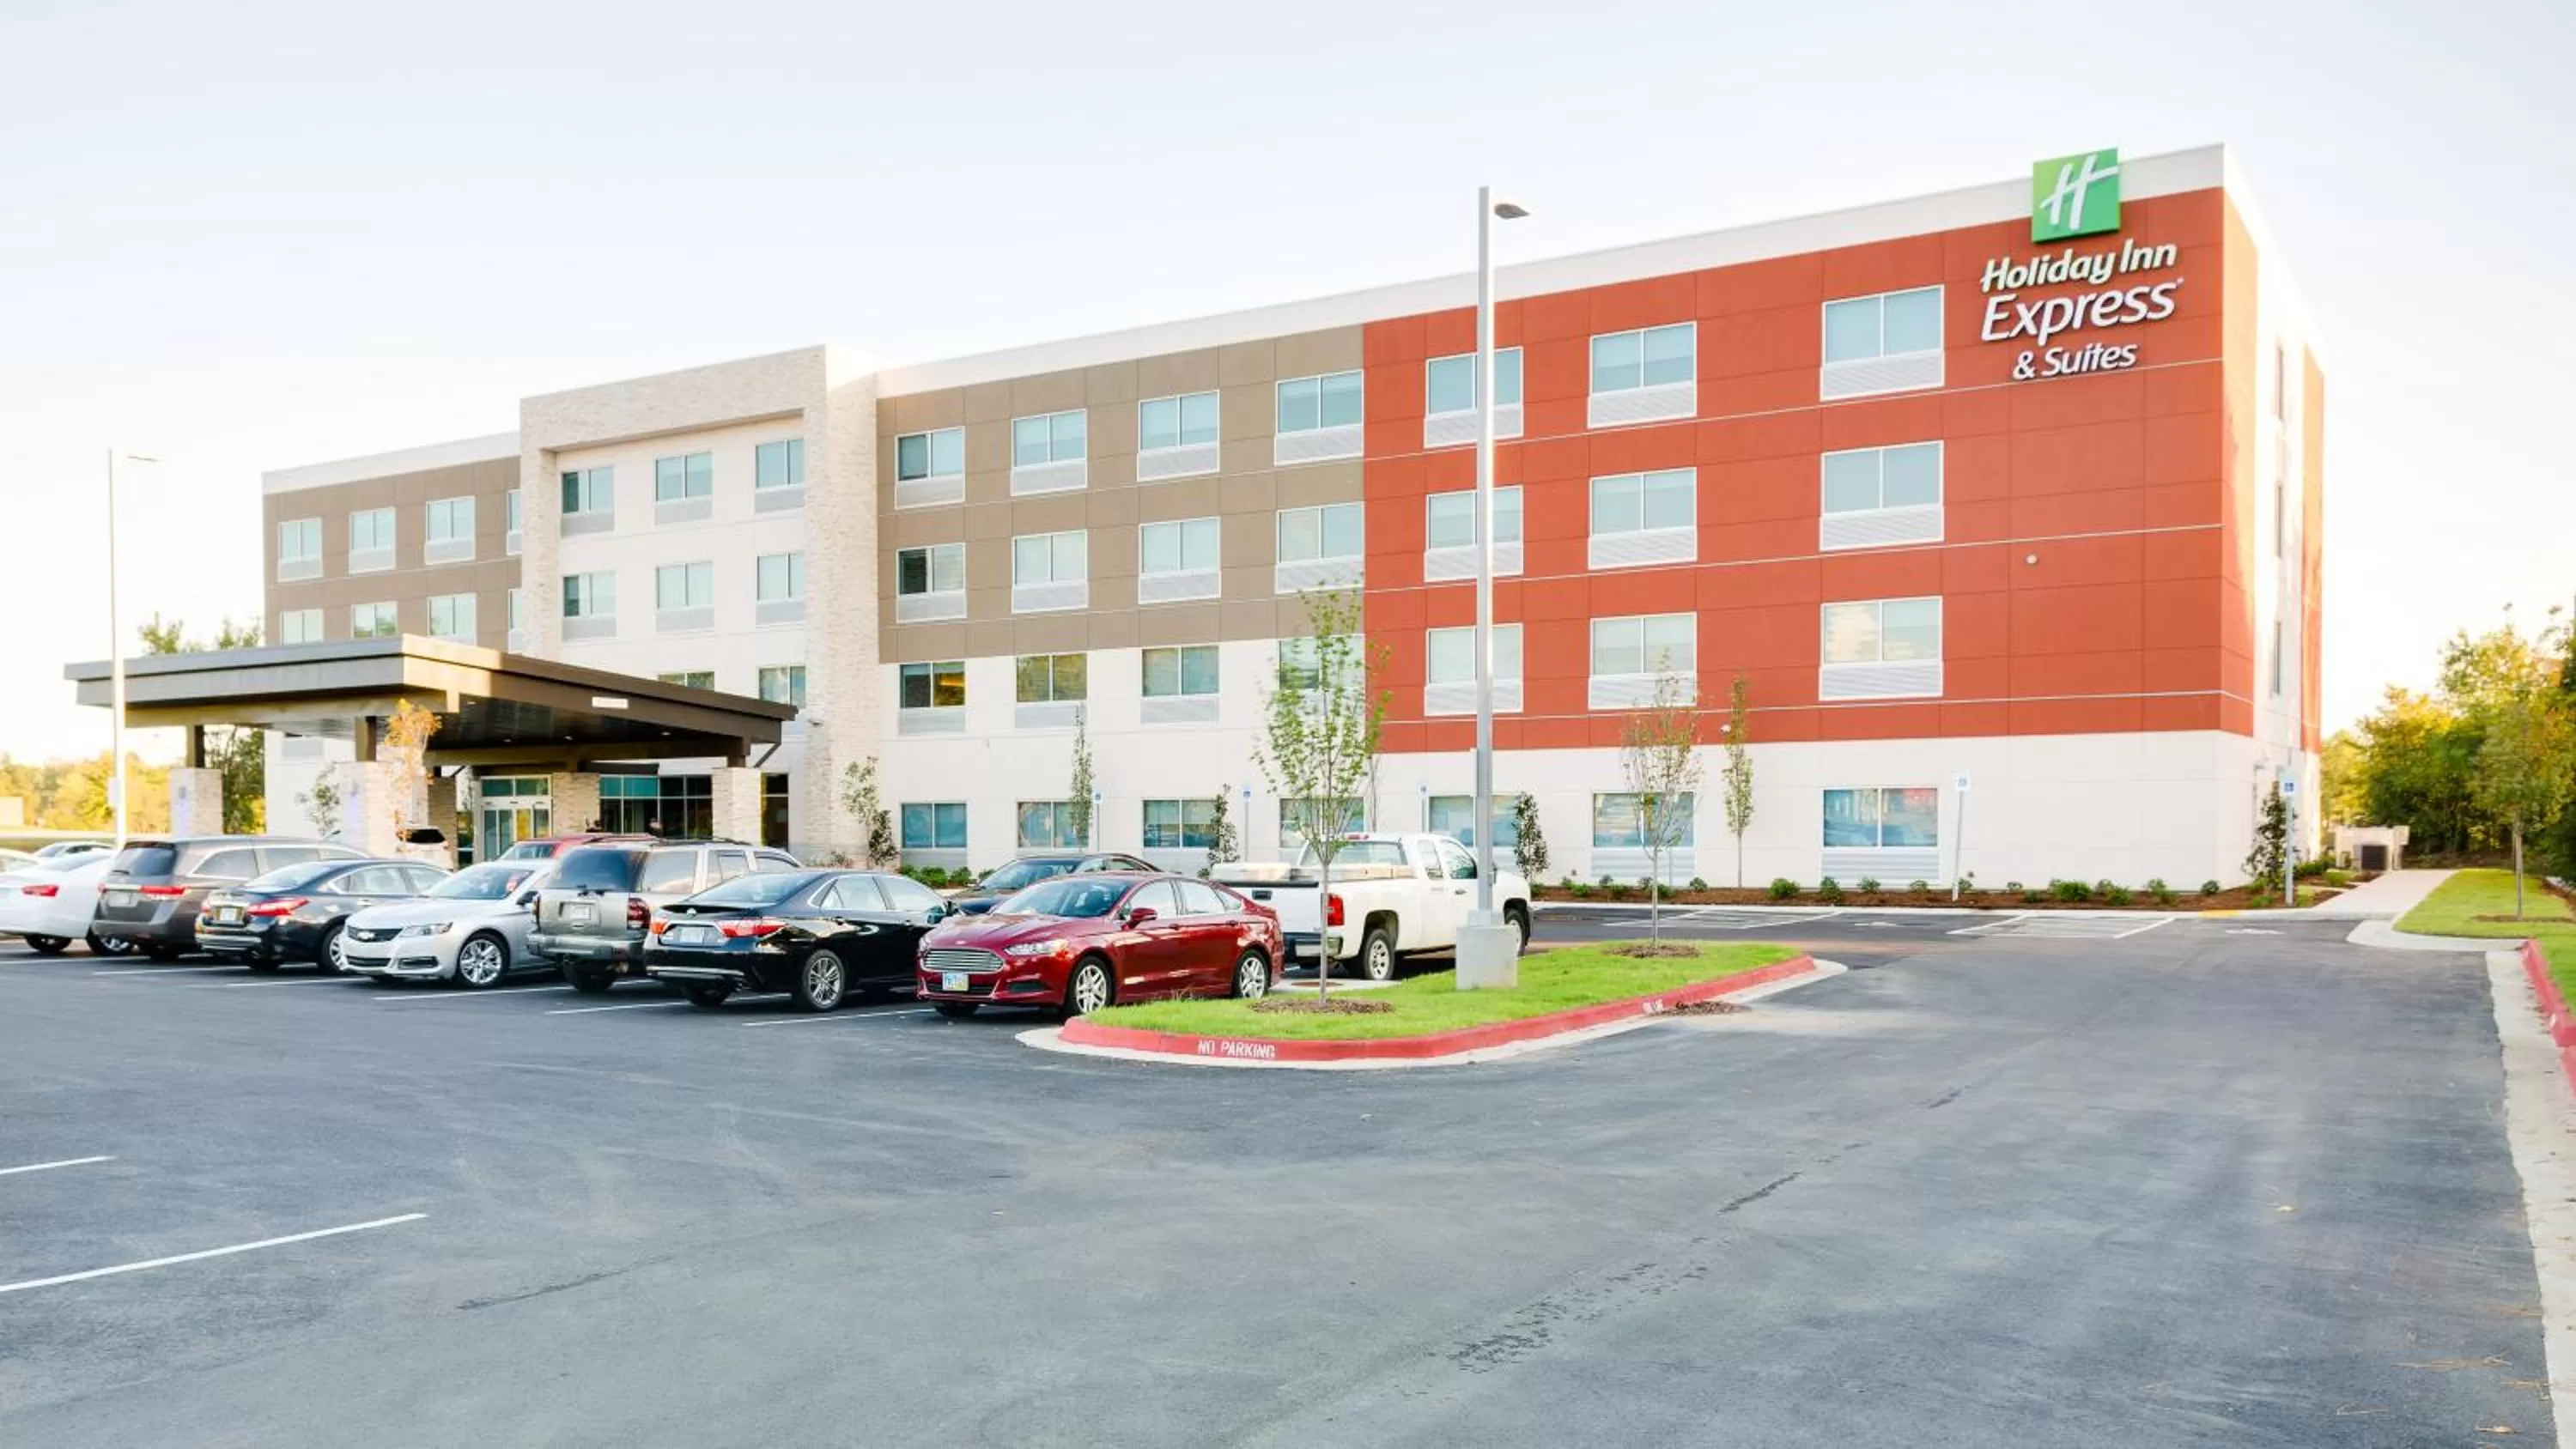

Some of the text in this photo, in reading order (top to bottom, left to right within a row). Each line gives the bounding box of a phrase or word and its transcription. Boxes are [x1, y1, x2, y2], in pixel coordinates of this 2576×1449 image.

[1979, 238, 2178, 293] Holiday Inn
[1981, 282, 2177, 346] Express
[2013, 343, 2137, 379] & Suites
[1198, 1040, 1275, 1058] NO PARKING
